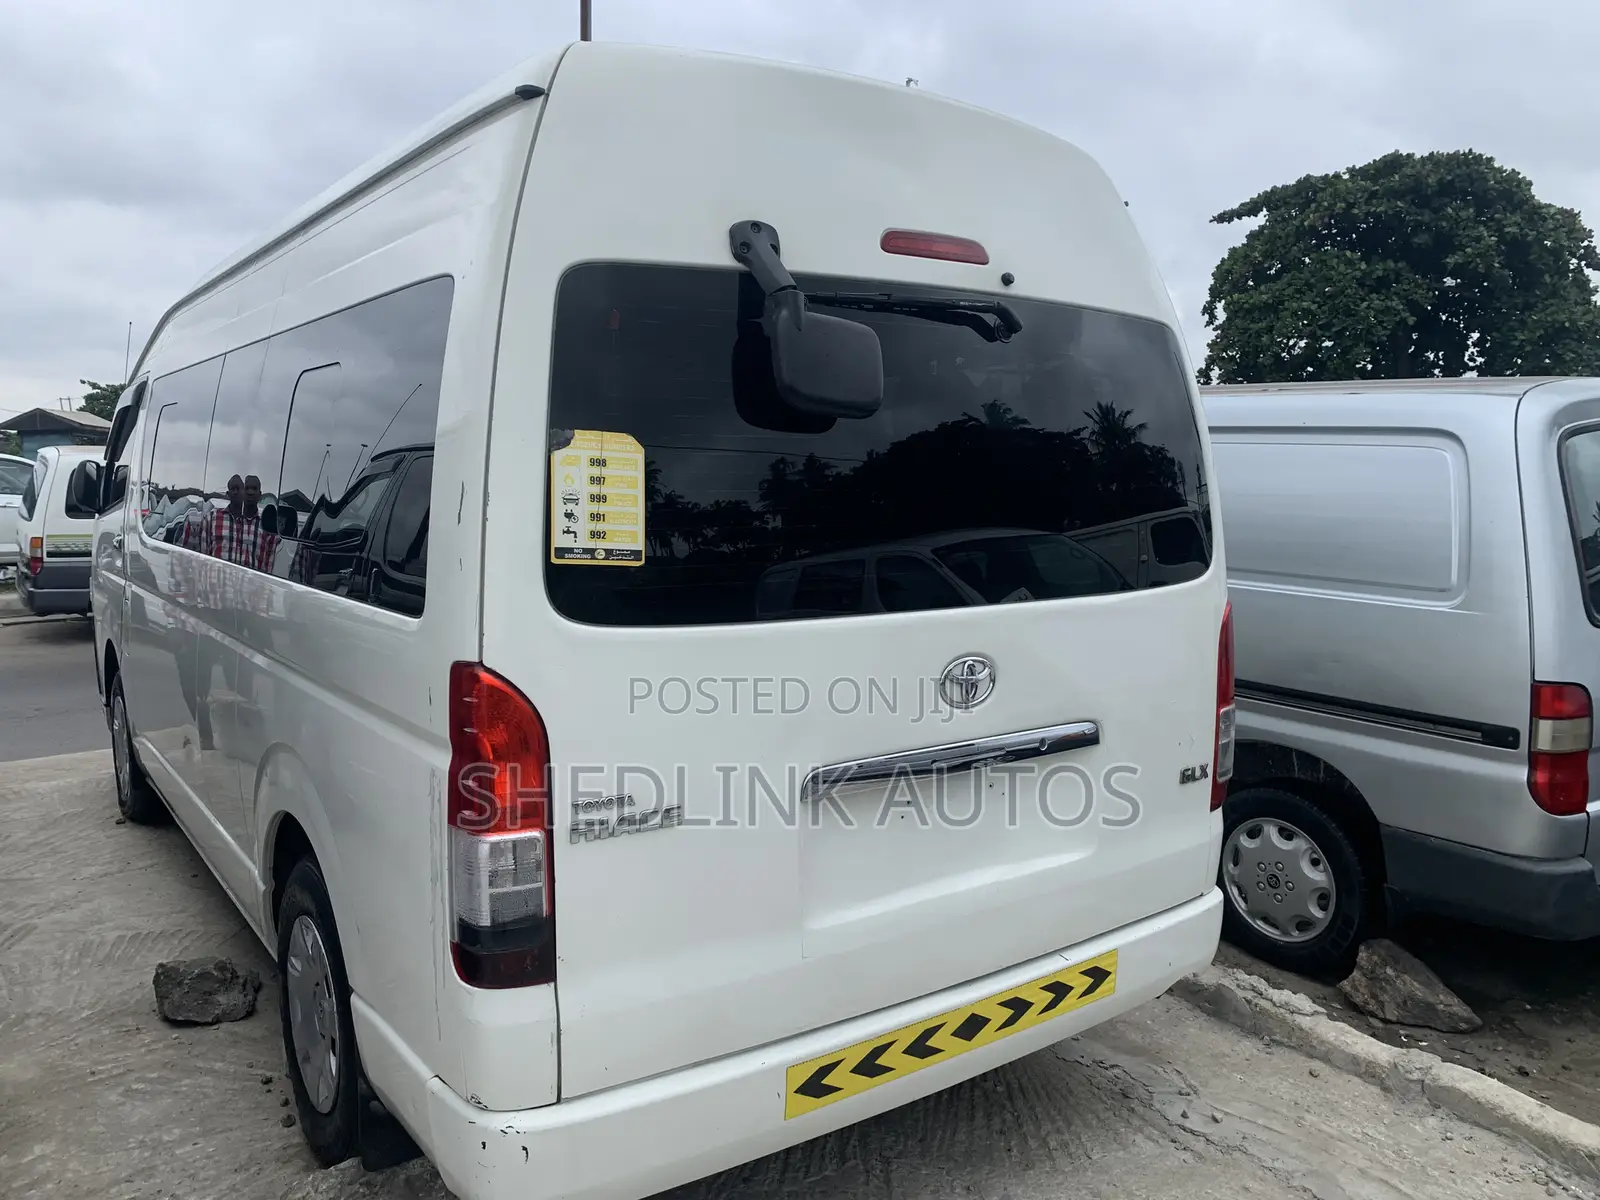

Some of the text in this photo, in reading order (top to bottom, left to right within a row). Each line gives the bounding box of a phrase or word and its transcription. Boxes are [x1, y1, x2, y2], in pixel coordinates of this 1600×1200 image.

[589, 457, 607, 468] 998
[589, 475, 606, 486] 997
[589, 494, 607, 504] 999
[589, 512, 606, 522] 991
[589, 530, 607, 540] 992
[1179, 763, 1209, 784] GLX
[571, 793, 636, 815] TOYOTA
[570, 804, 683, 844] HIACE
